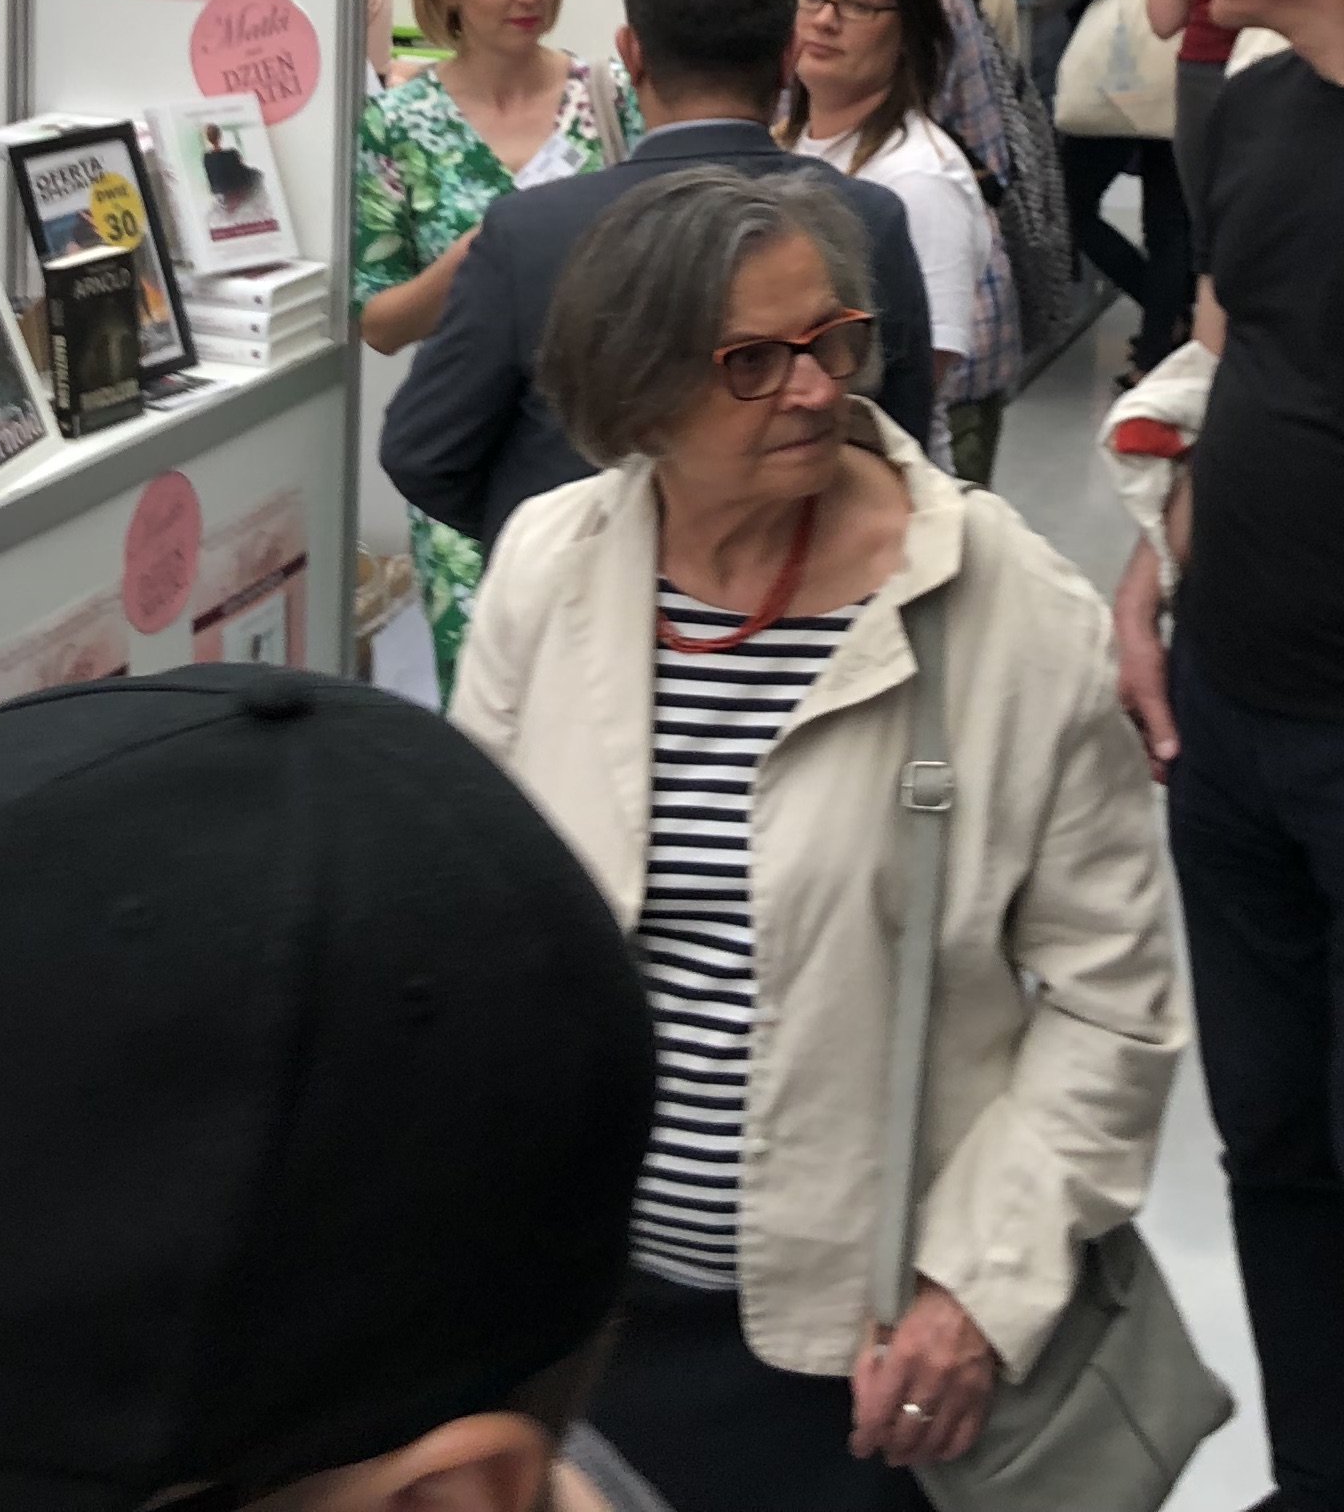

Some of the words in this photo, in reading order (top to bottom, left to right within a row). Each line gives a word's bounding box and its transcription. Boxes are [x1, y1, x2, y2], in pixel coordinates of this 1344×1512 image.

[201, 2, 291, 52] Matki
[35, 155, 105, 190] OFERTA
[105, 209, 138, 241] 30
